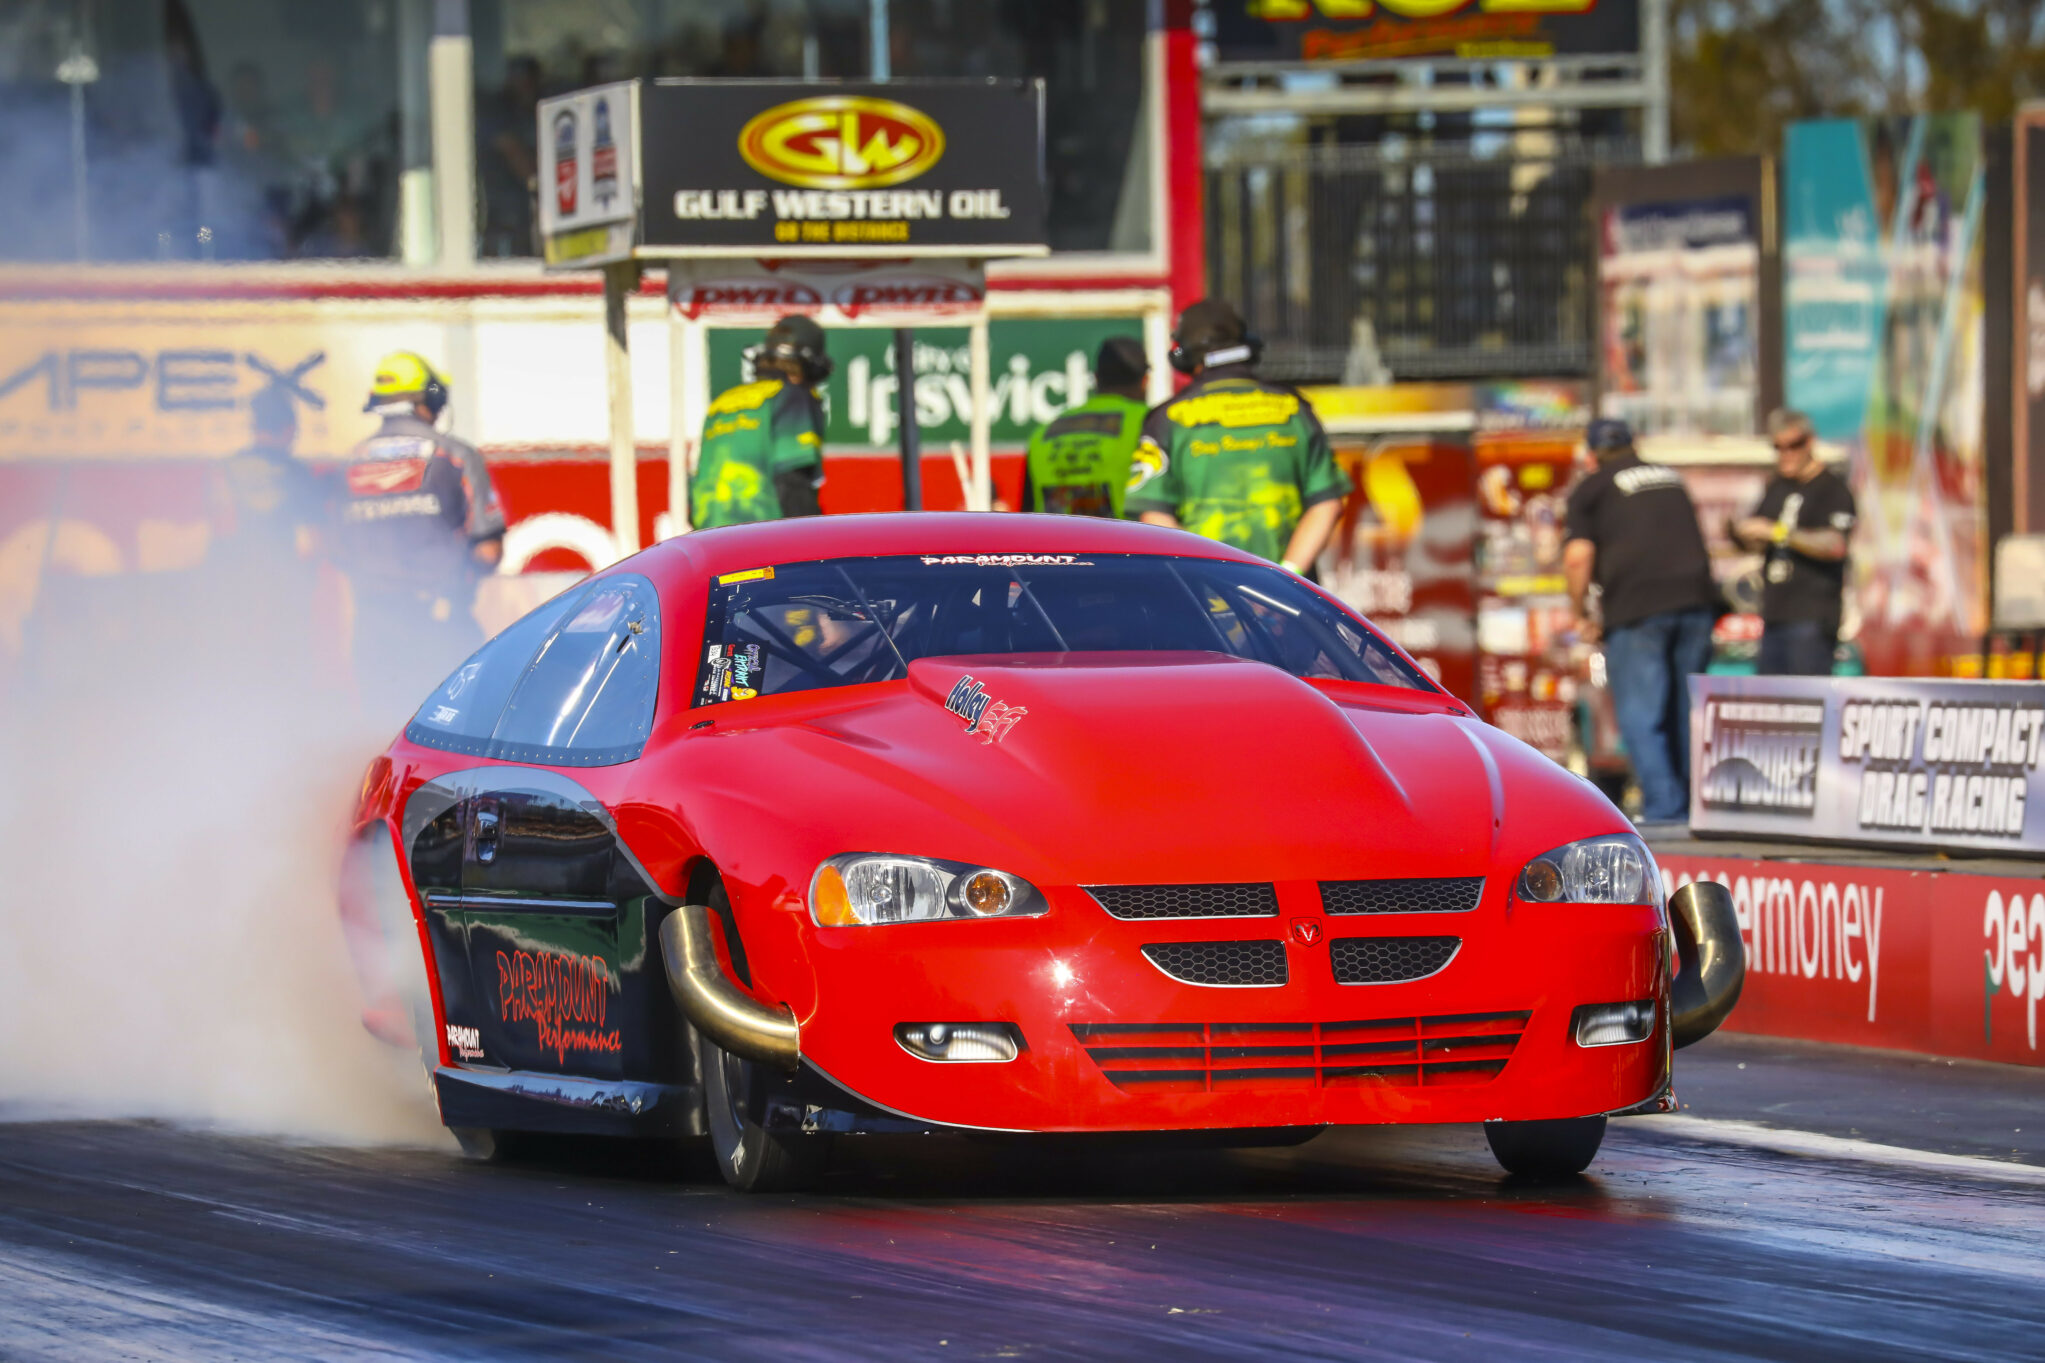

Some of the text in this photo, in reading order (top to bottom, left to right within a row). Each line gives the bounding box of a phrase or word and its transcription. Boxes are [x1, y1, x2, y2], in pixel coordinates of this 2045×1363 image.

[673, 189, 1008, 219] GULF WESTERN OIL
[0, 349, 327, 411] APEX
[920, 555, 1077, 565] PARAMOUNT
[1841, 702, 2044, 768] SPORT COMPACT
[1860, 771, 2027, 836] DRAG RACING
[1661, 867, 1884, 1022] ermoney
[496, 950, 608, 1028] PARAMOUNT
[446, 1024, 480, 1049] PARAMOUNT
[537, 1010, 622, 1067] Performance
